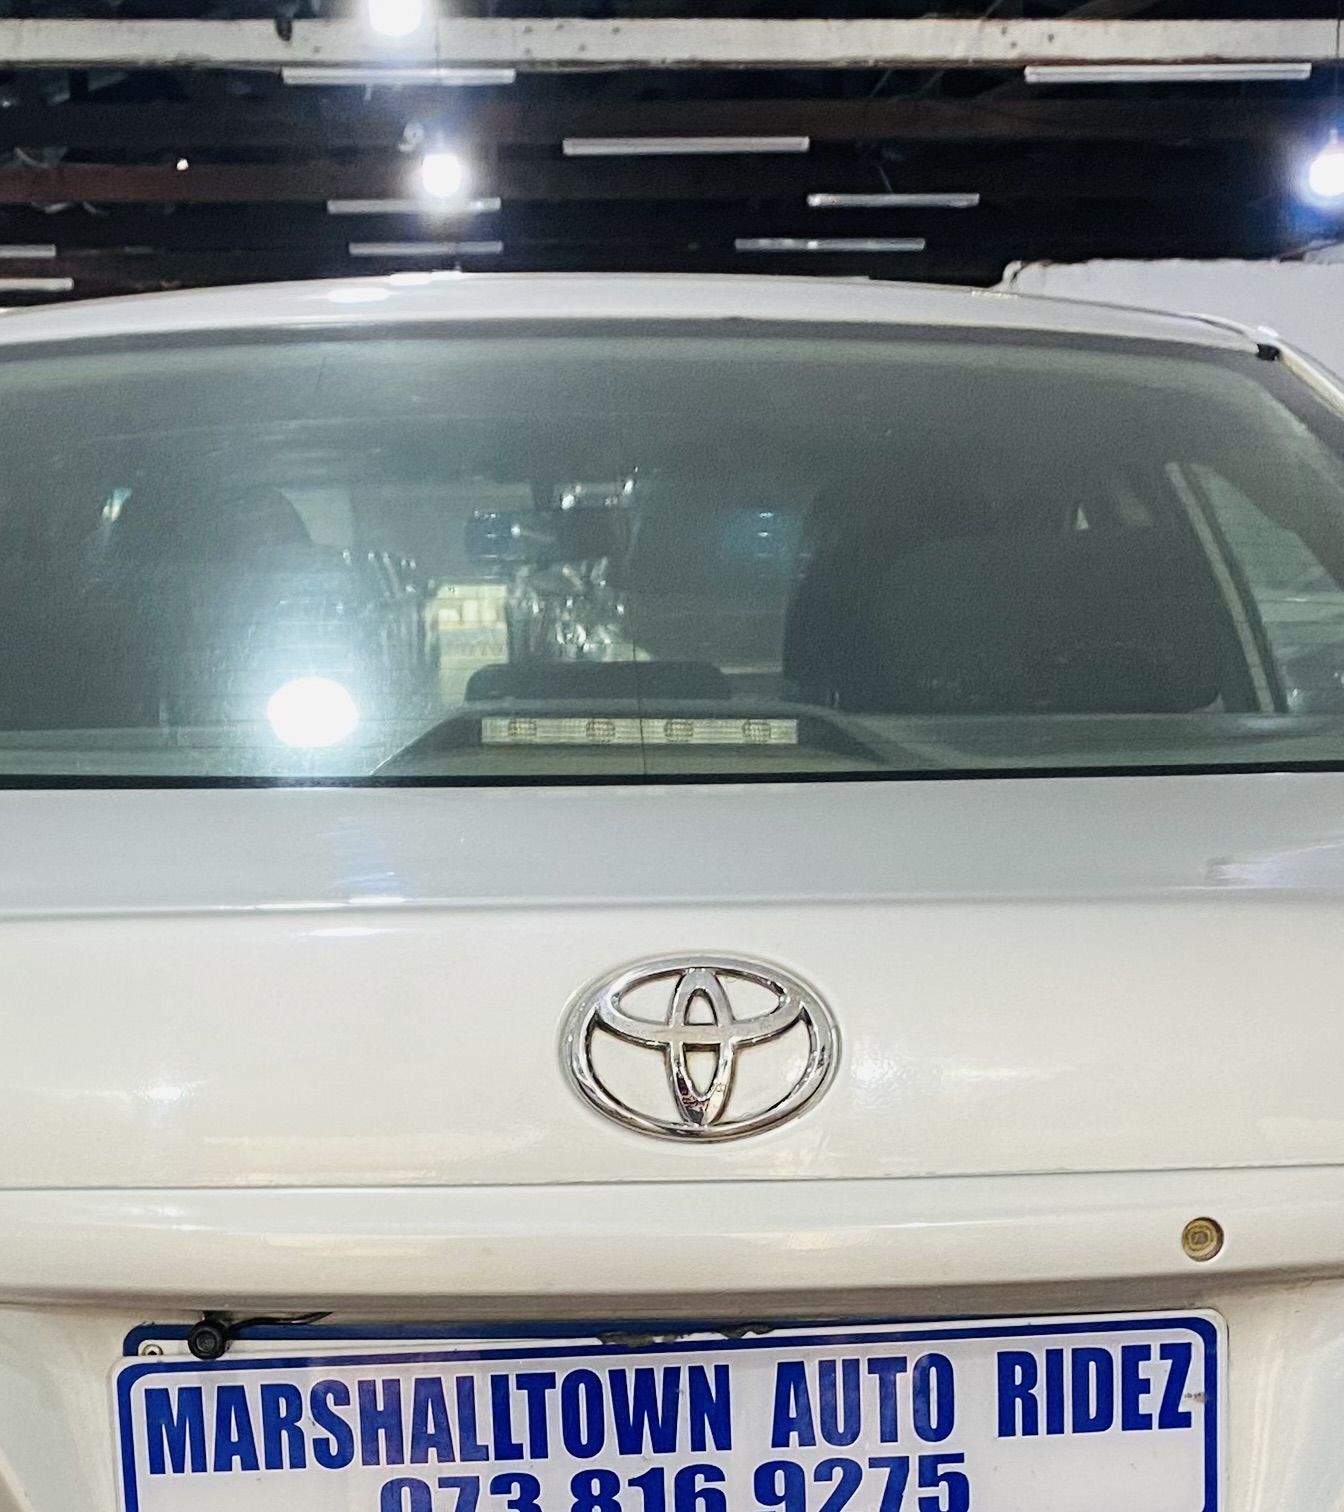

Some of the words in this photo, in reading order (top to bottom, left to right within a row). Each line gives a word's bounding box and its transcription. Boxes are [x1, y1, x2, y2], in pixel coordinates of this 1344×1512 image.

[144, 1364, 733, 1475] MARSHALLTOWN
[771, 1353, 956, 1449] AUTO
[996, 1342, 1194, 1438] RIDEZ
